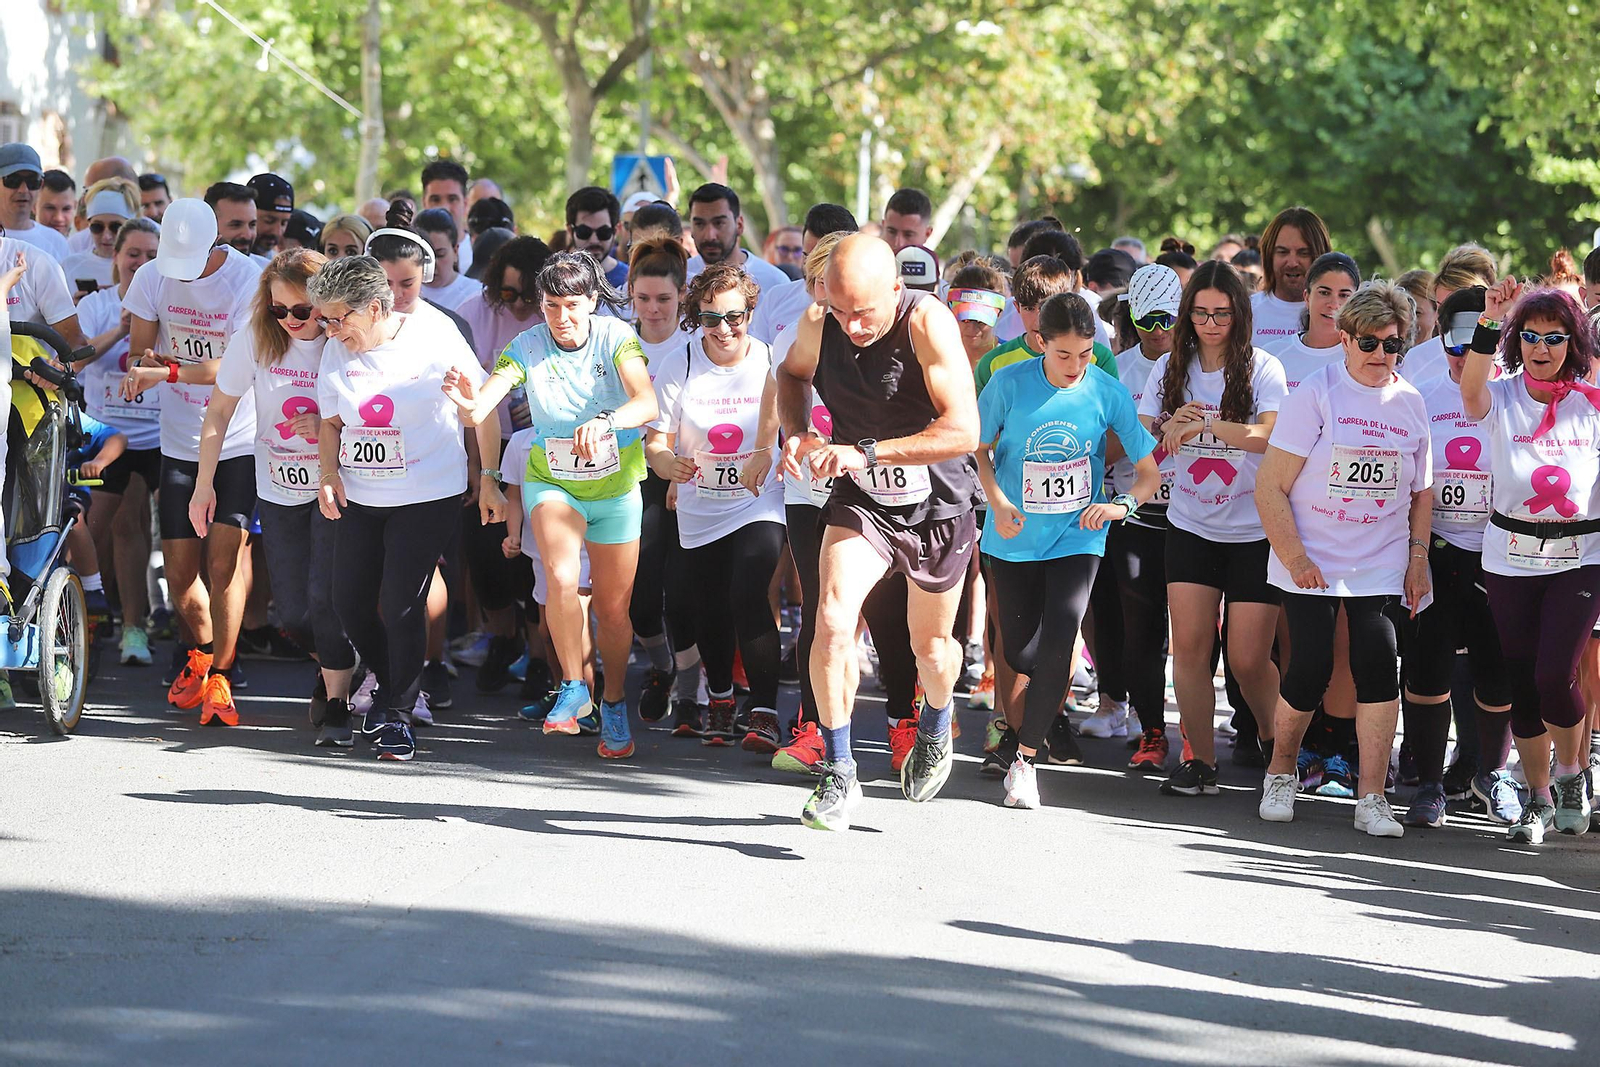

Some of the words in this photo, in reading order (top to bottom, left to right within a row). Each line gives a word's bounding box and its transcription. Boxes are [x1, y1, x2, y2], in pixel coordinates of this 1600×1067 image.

[168, 305, 197, 317] CARRERA
[214, 313, 229, 321] MUJE
[190, 318, 211, 328] HUELVA
[1256, 328, 1286, 336] CARRERA
[184, 338, 213, 360] 101
[270, 366, 299, 378] CARRERA
[300, 370, 310, 379] DE
[291, 379, 315, 388] HUELVA
[721, 397, 731, 406] DE
[732, 397, 742, 405] LA
[743, 396, 761, 404] MUJE
[1432, 411, 1461, 423] CARRERA
[1031, 420, 1079, 438] ONUBENSE
[1337, 416, 1369, 427] CARRERA
[1369, 420, 1379, 429] DE
[1380, 422, 1389, 431] LA
[1389, 425, 1409, 438] MUJER
[1362, 429, 1386, 439] HUELVA
[1545, 439, 1556, 448] DE
[353, 441, 387, 463] 200
[1367, 449, 1374, 457] DE
[1374, 449, 1382, 457] LA
[278, 465, 310, 486] 160
[714, 467, 739, 486] 78
[866, 466, 908, 489] 118
[1346, 461, 1385, 484] 205
[1461, 472, 1469, 480] LA
[1469, 473, 1489, 481] MUJER
[1041, 475, 1075, 498] 131
[1441, 484, 1466, 506] 69
[1311, 504, 1336, 516] Huelva
